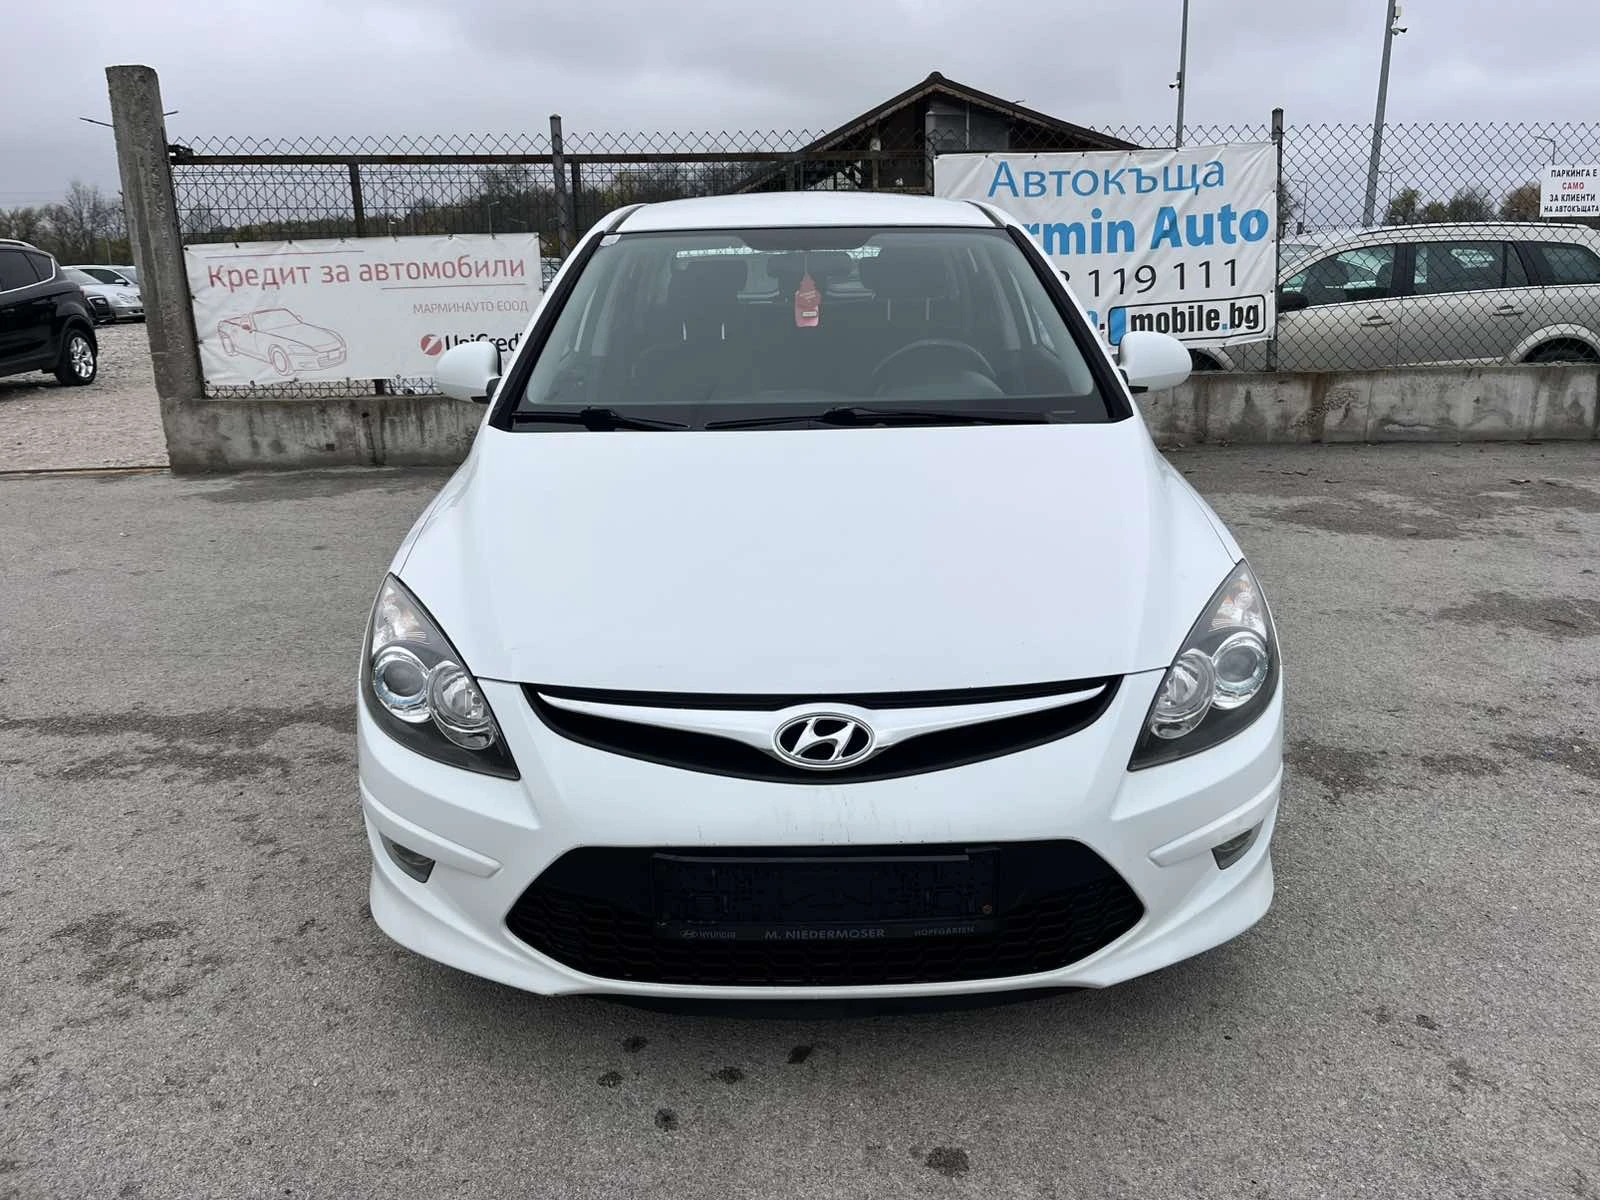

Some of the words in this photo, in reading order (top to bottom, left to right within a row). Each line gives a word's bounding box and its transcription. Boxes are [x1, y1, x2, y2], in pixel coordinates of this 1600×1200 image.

[988, 160, 1225, 197] Автокъща
[1551, 169, 1590, 177] ПАРКИНГА
[1593, 169, 1597, 177] Е
[1562, 182, 1584, 190] САМО
[1550, 194, 1559, 202] ЗА
[1561, 194, 1596, 202] КЛИЕНТИ
[1544, 205, 1553, 213] НА
[1555, 205, 1600, 213] АВТОКЪЩАТА
[1150, 204, 1269, 248] Auto
[207, 264, 312, 293] Кредит
[320, 264, 350, 284] за
[359, 254, 526, 282] автомобили
[1088, 264, 1157, 296] 119
[1173, 258, 1236, 290] 111
[413, 301, 494, 314] МАРМИНАУТО
[498, 300, 529, 313] ЕООД
[1131, 302, 1260, 333] mobile.bg
[445, 332, 523, 352] UCred
[786, 927, 886, 940] NIEDERMOSER
